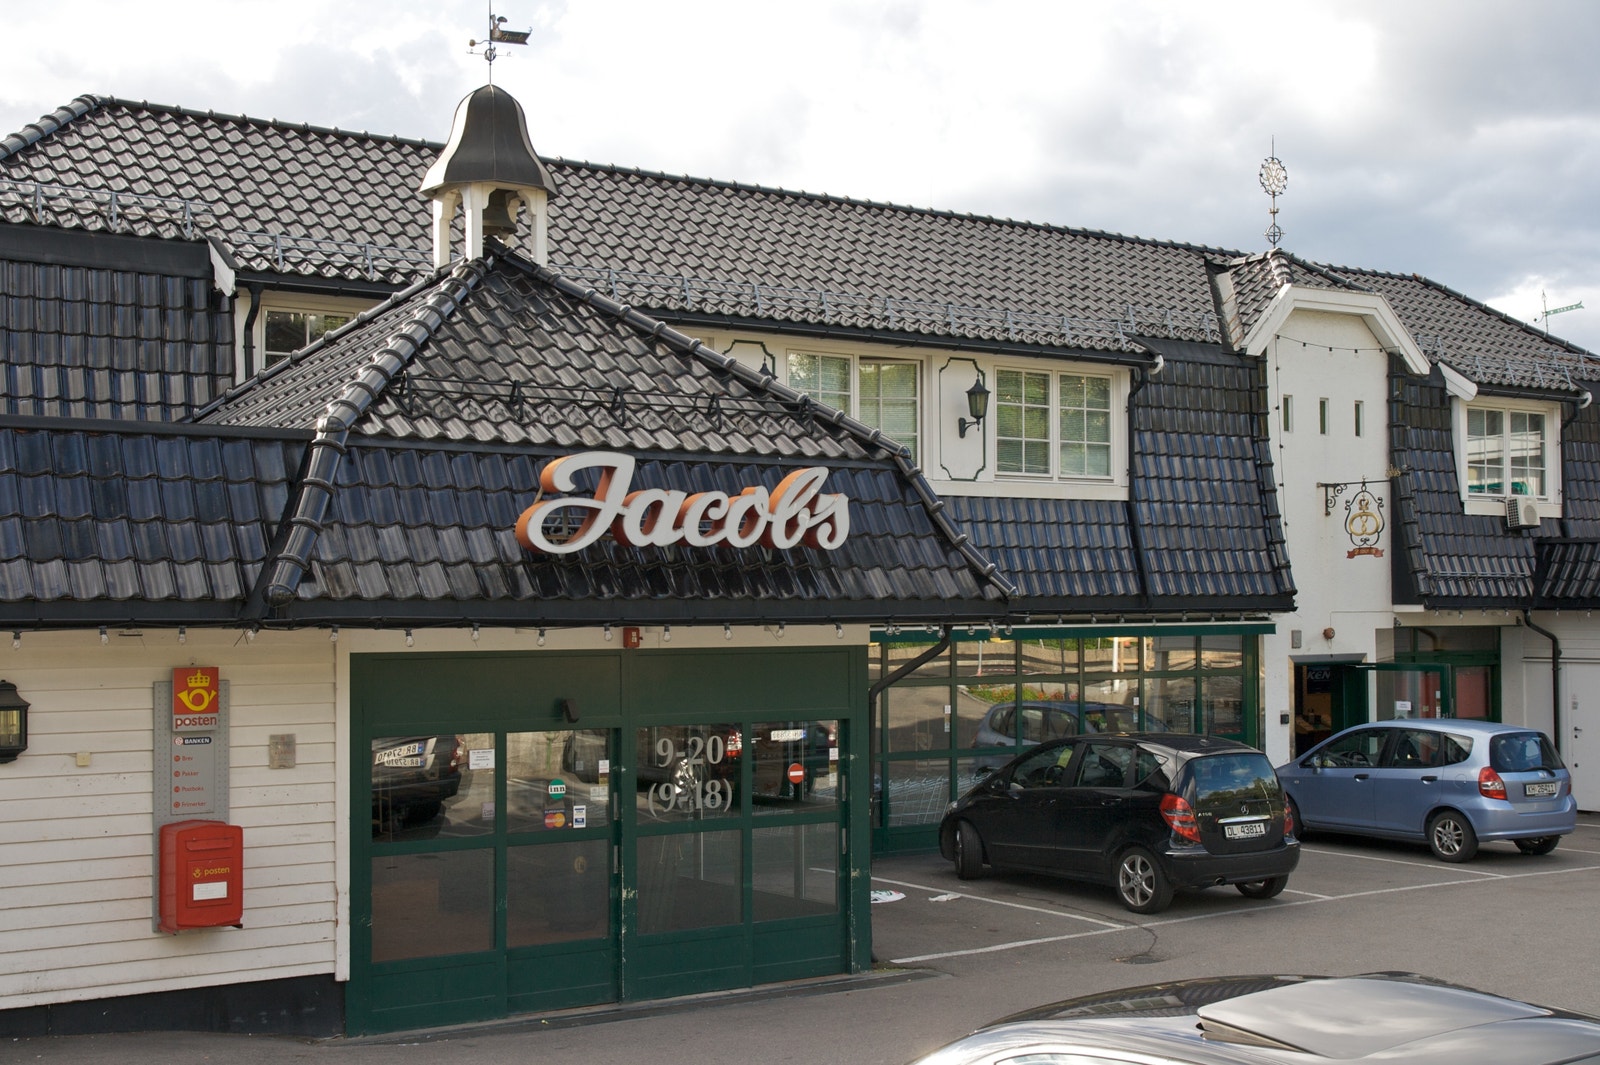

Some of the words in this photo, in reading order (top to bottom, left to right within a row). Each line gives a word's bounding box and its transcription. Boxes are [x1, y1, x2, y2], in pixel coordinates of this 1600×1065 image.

[519, 451, 849, 554] Jacobs
[175, 715, 217, 730] posten
[656, 735, 724, 767] 9-20
[648, 778, 733, 817] (9-18)
[1240, 824, 1263, 834] 43811
[204, 866, 230, 877] posten
